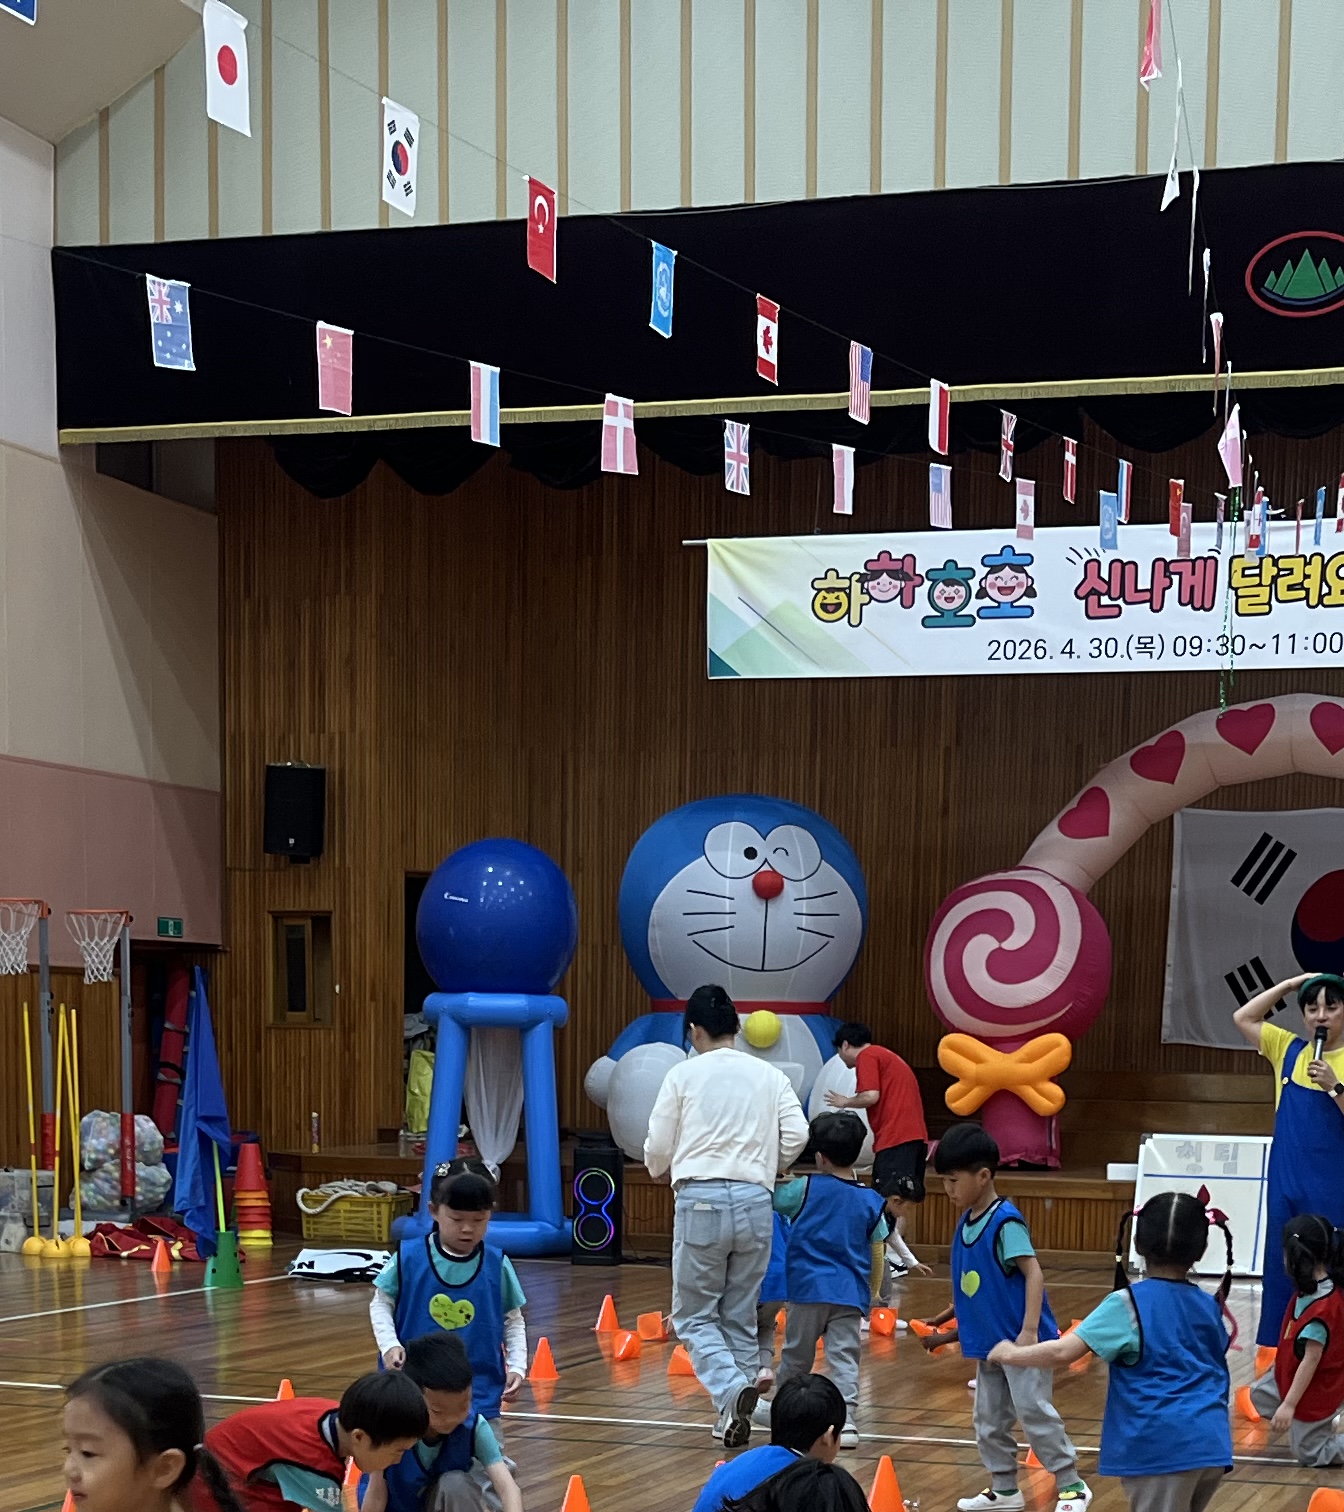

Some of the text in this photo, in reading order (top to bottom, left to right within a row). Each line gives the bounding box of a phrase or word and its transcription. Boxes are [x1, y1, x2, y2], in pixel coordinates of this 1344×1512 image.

[810, 544, 1038, 628] 하하호호
[1074, 556, 1218, 619] 신나게
[987, 638, 1054, 661] 2026.
[1060, 637, 1081, 660] 4.
[1088, 633, 1165, 661] 30.(목)
[1172, 631, 1344, 658] 09:30~11:00
